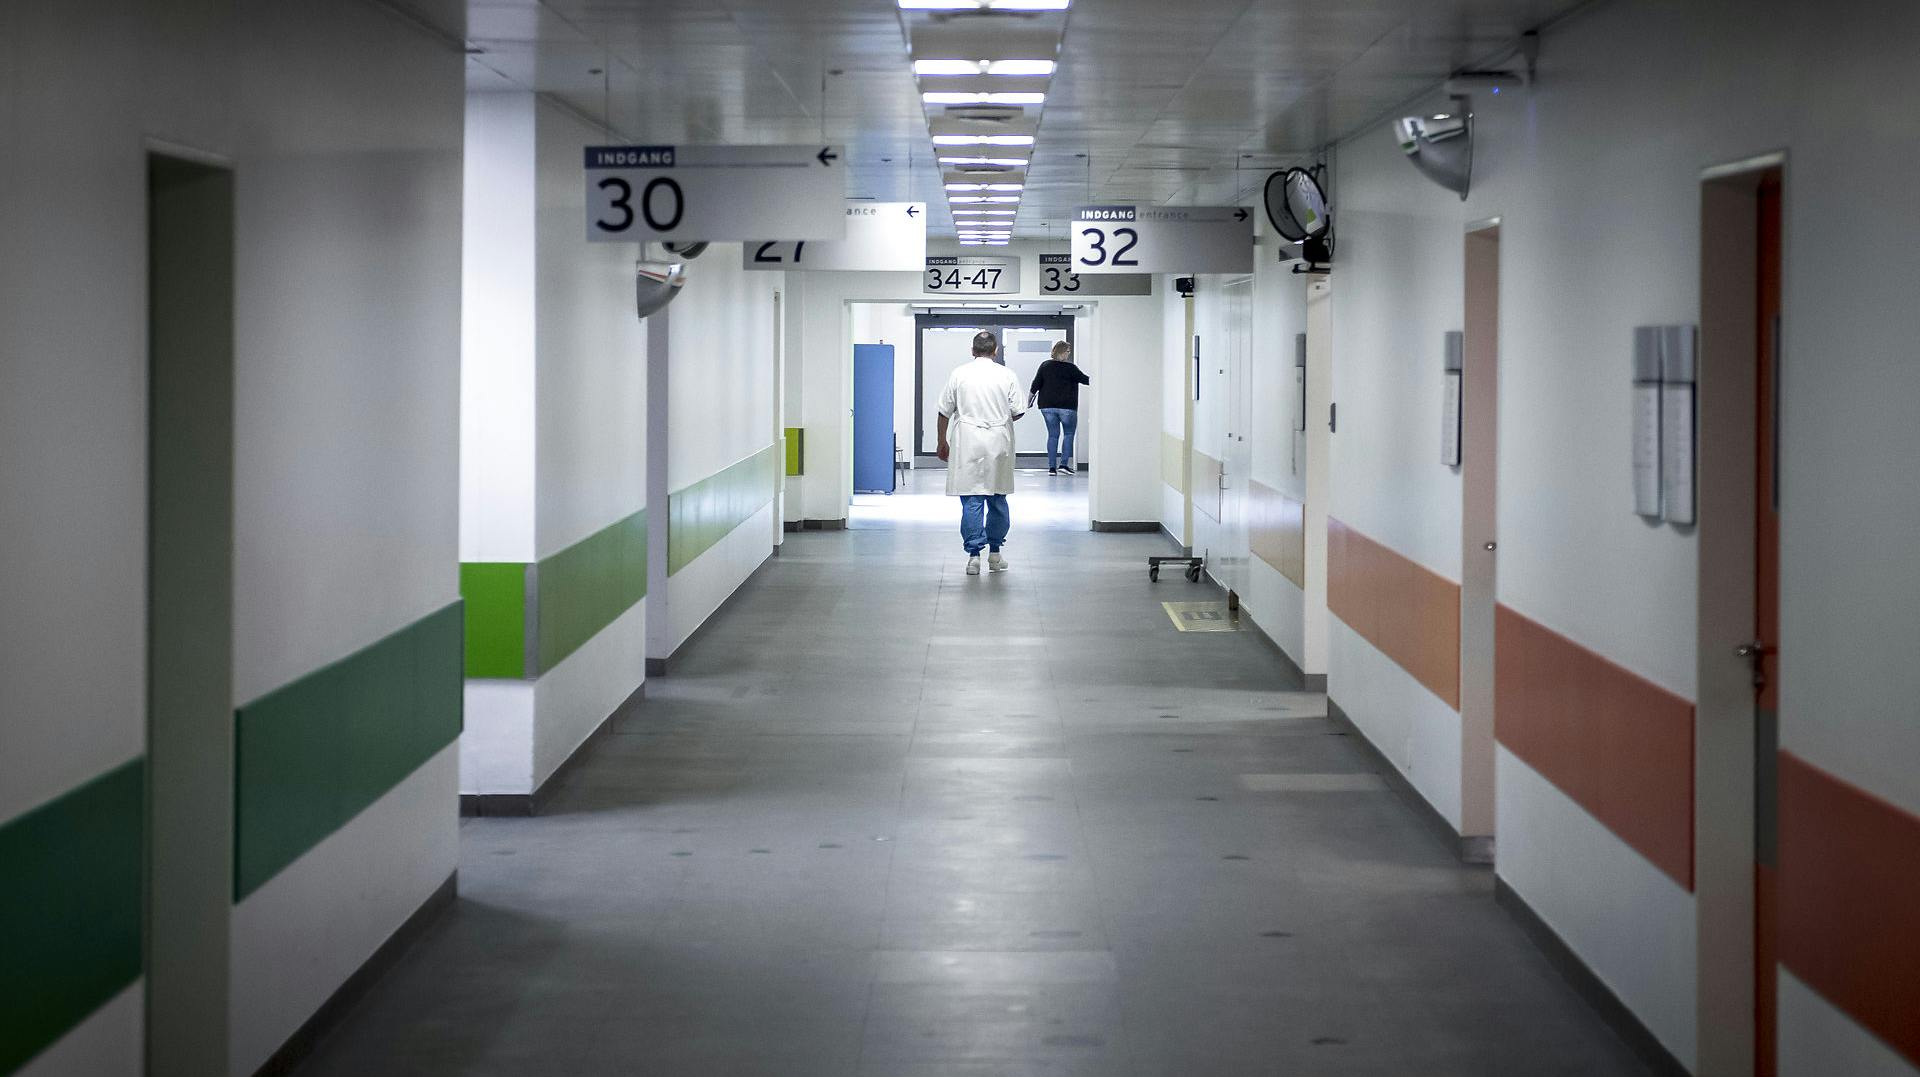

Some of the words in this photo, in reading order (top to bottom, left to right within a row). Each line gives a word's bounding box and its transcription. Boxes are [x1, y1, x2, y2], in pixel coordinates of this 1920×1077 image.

[597, 152, 673, 165] INDGANG
[596, 176, 685, 233] 30
[846, 207, 877, 216] ance
[1081, 210, 1135, 220] INDGANG
[1139, 210, 1189, 220] entrance
[1079, 227, 1139, 267] 32
[927, 268, 1002, 290] 34-47
[1043, 267, 1081, 292] 33
